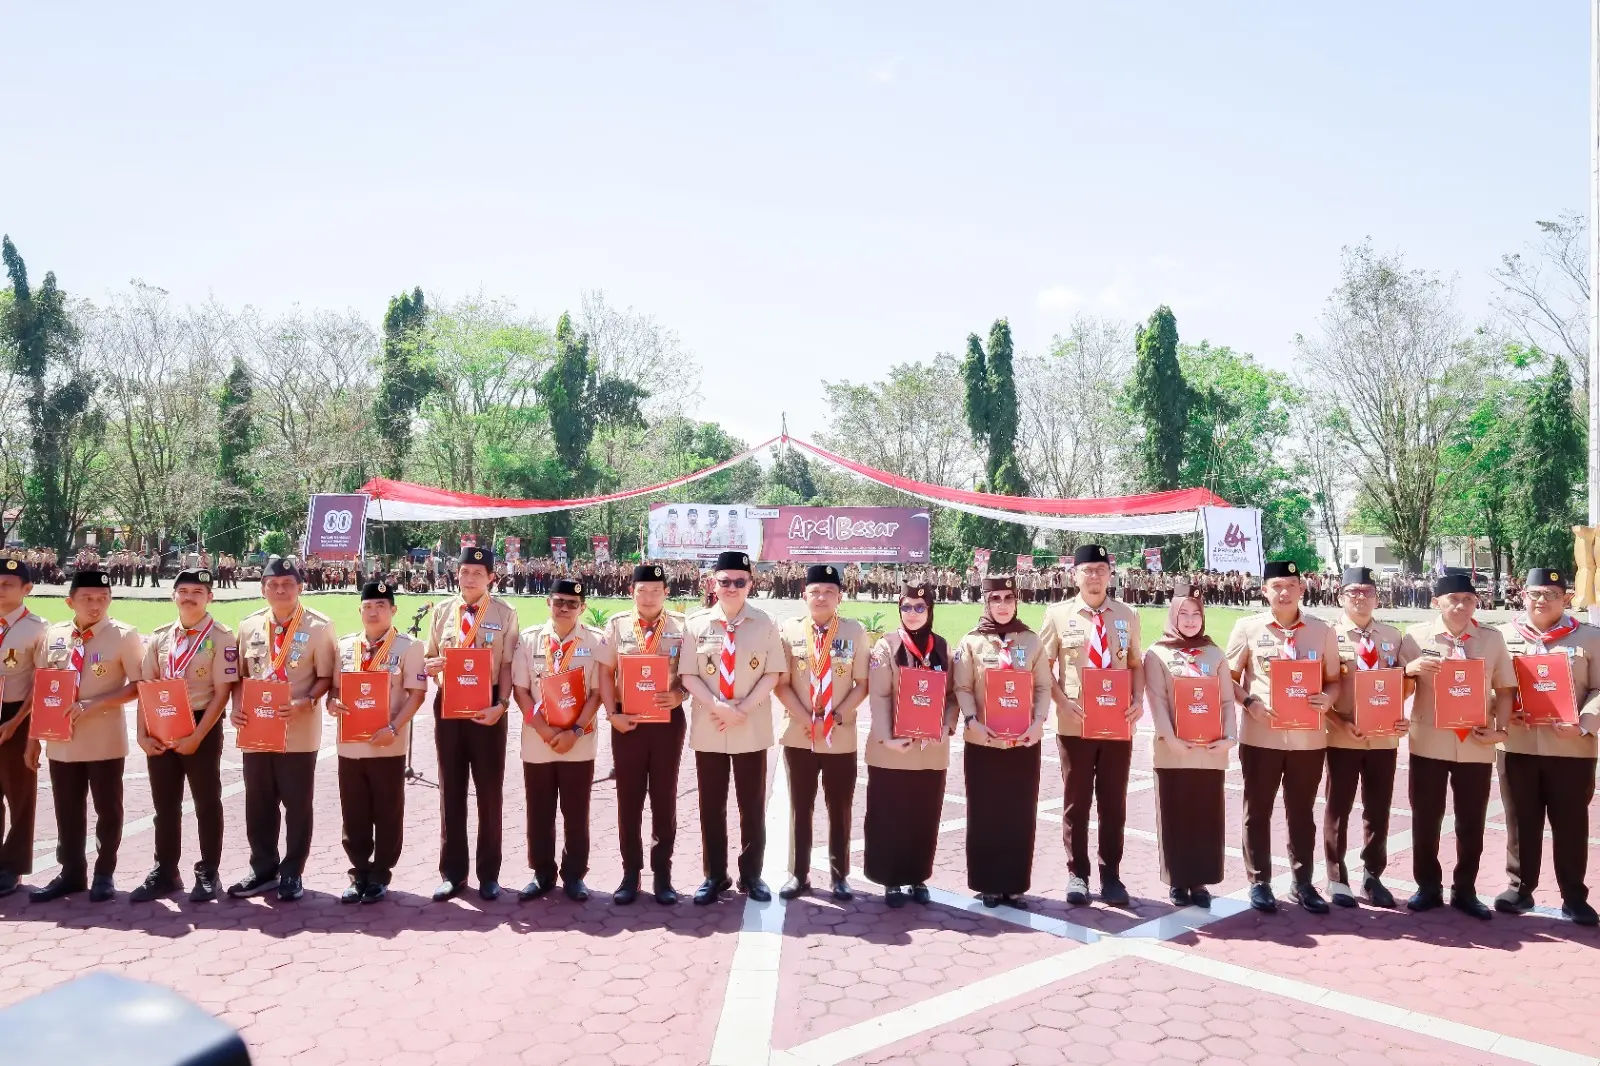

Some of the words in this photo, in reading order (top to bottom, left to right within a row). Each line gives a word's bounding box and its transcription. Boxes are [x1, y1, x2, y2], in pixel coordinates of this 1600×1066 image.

[323, 509, 353, 534] 80
[788, 515, 835, 541] Apel
[836, 516, 900, 541] Besar
